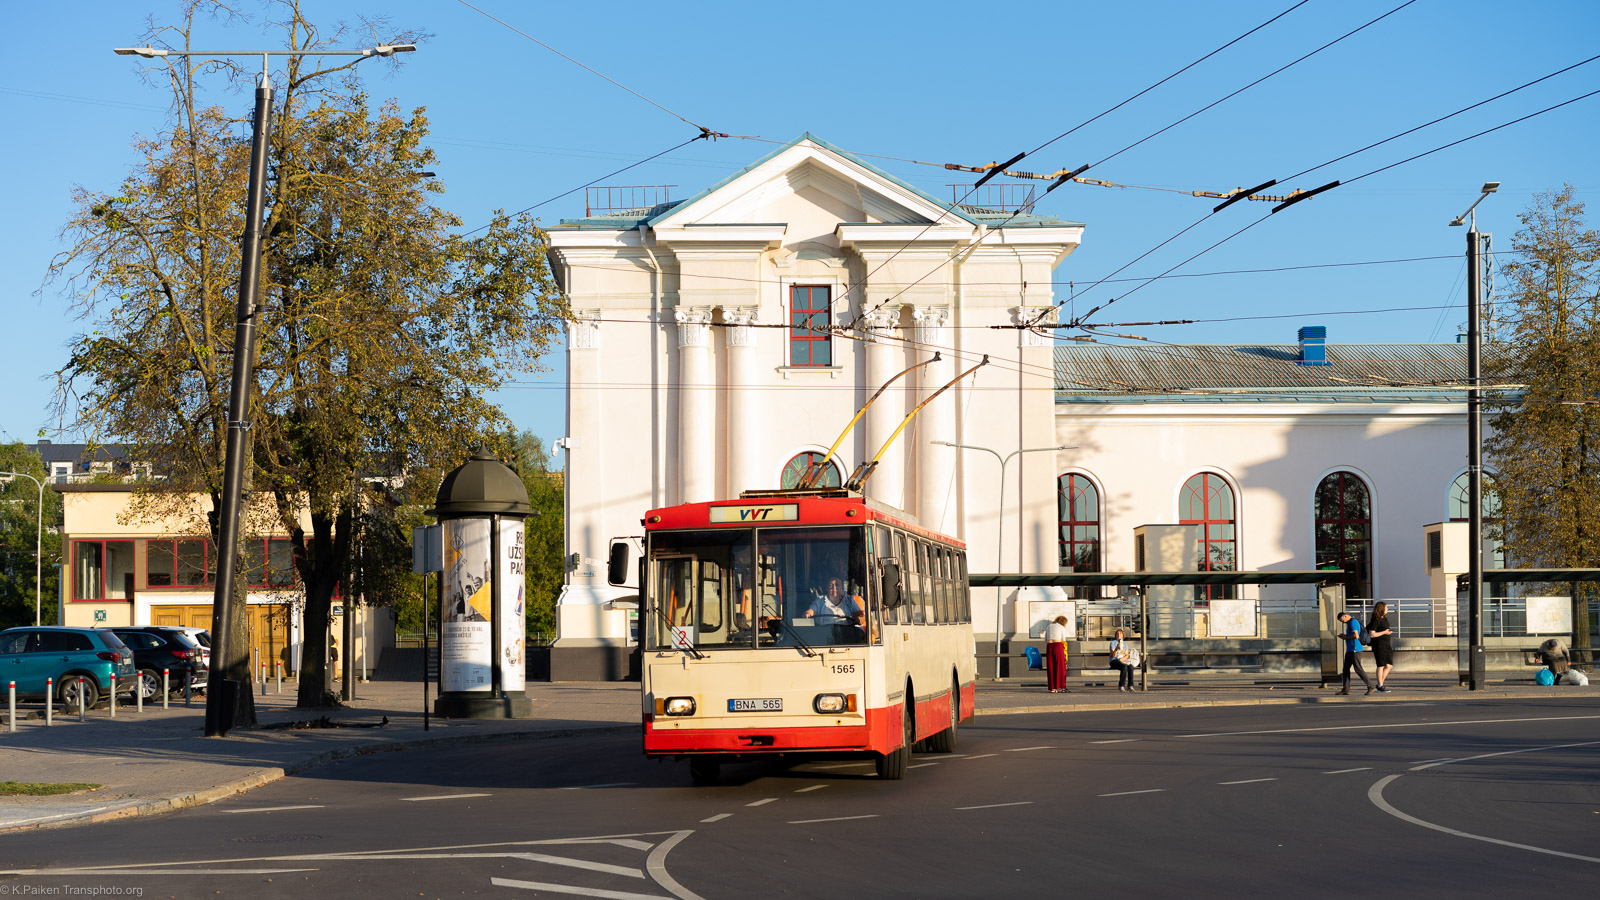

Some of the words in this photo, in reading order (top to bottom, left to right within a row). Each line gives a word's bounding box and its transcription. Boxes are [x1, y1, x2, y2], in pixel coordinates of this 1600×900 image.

[740, 508, 773, 520] VVT
[679, 631, 687, 645] 2
[831, 664, 855, 674] 1565
[735, 700, 757, 710] BNA
[762, 699, 780, 709] 565
